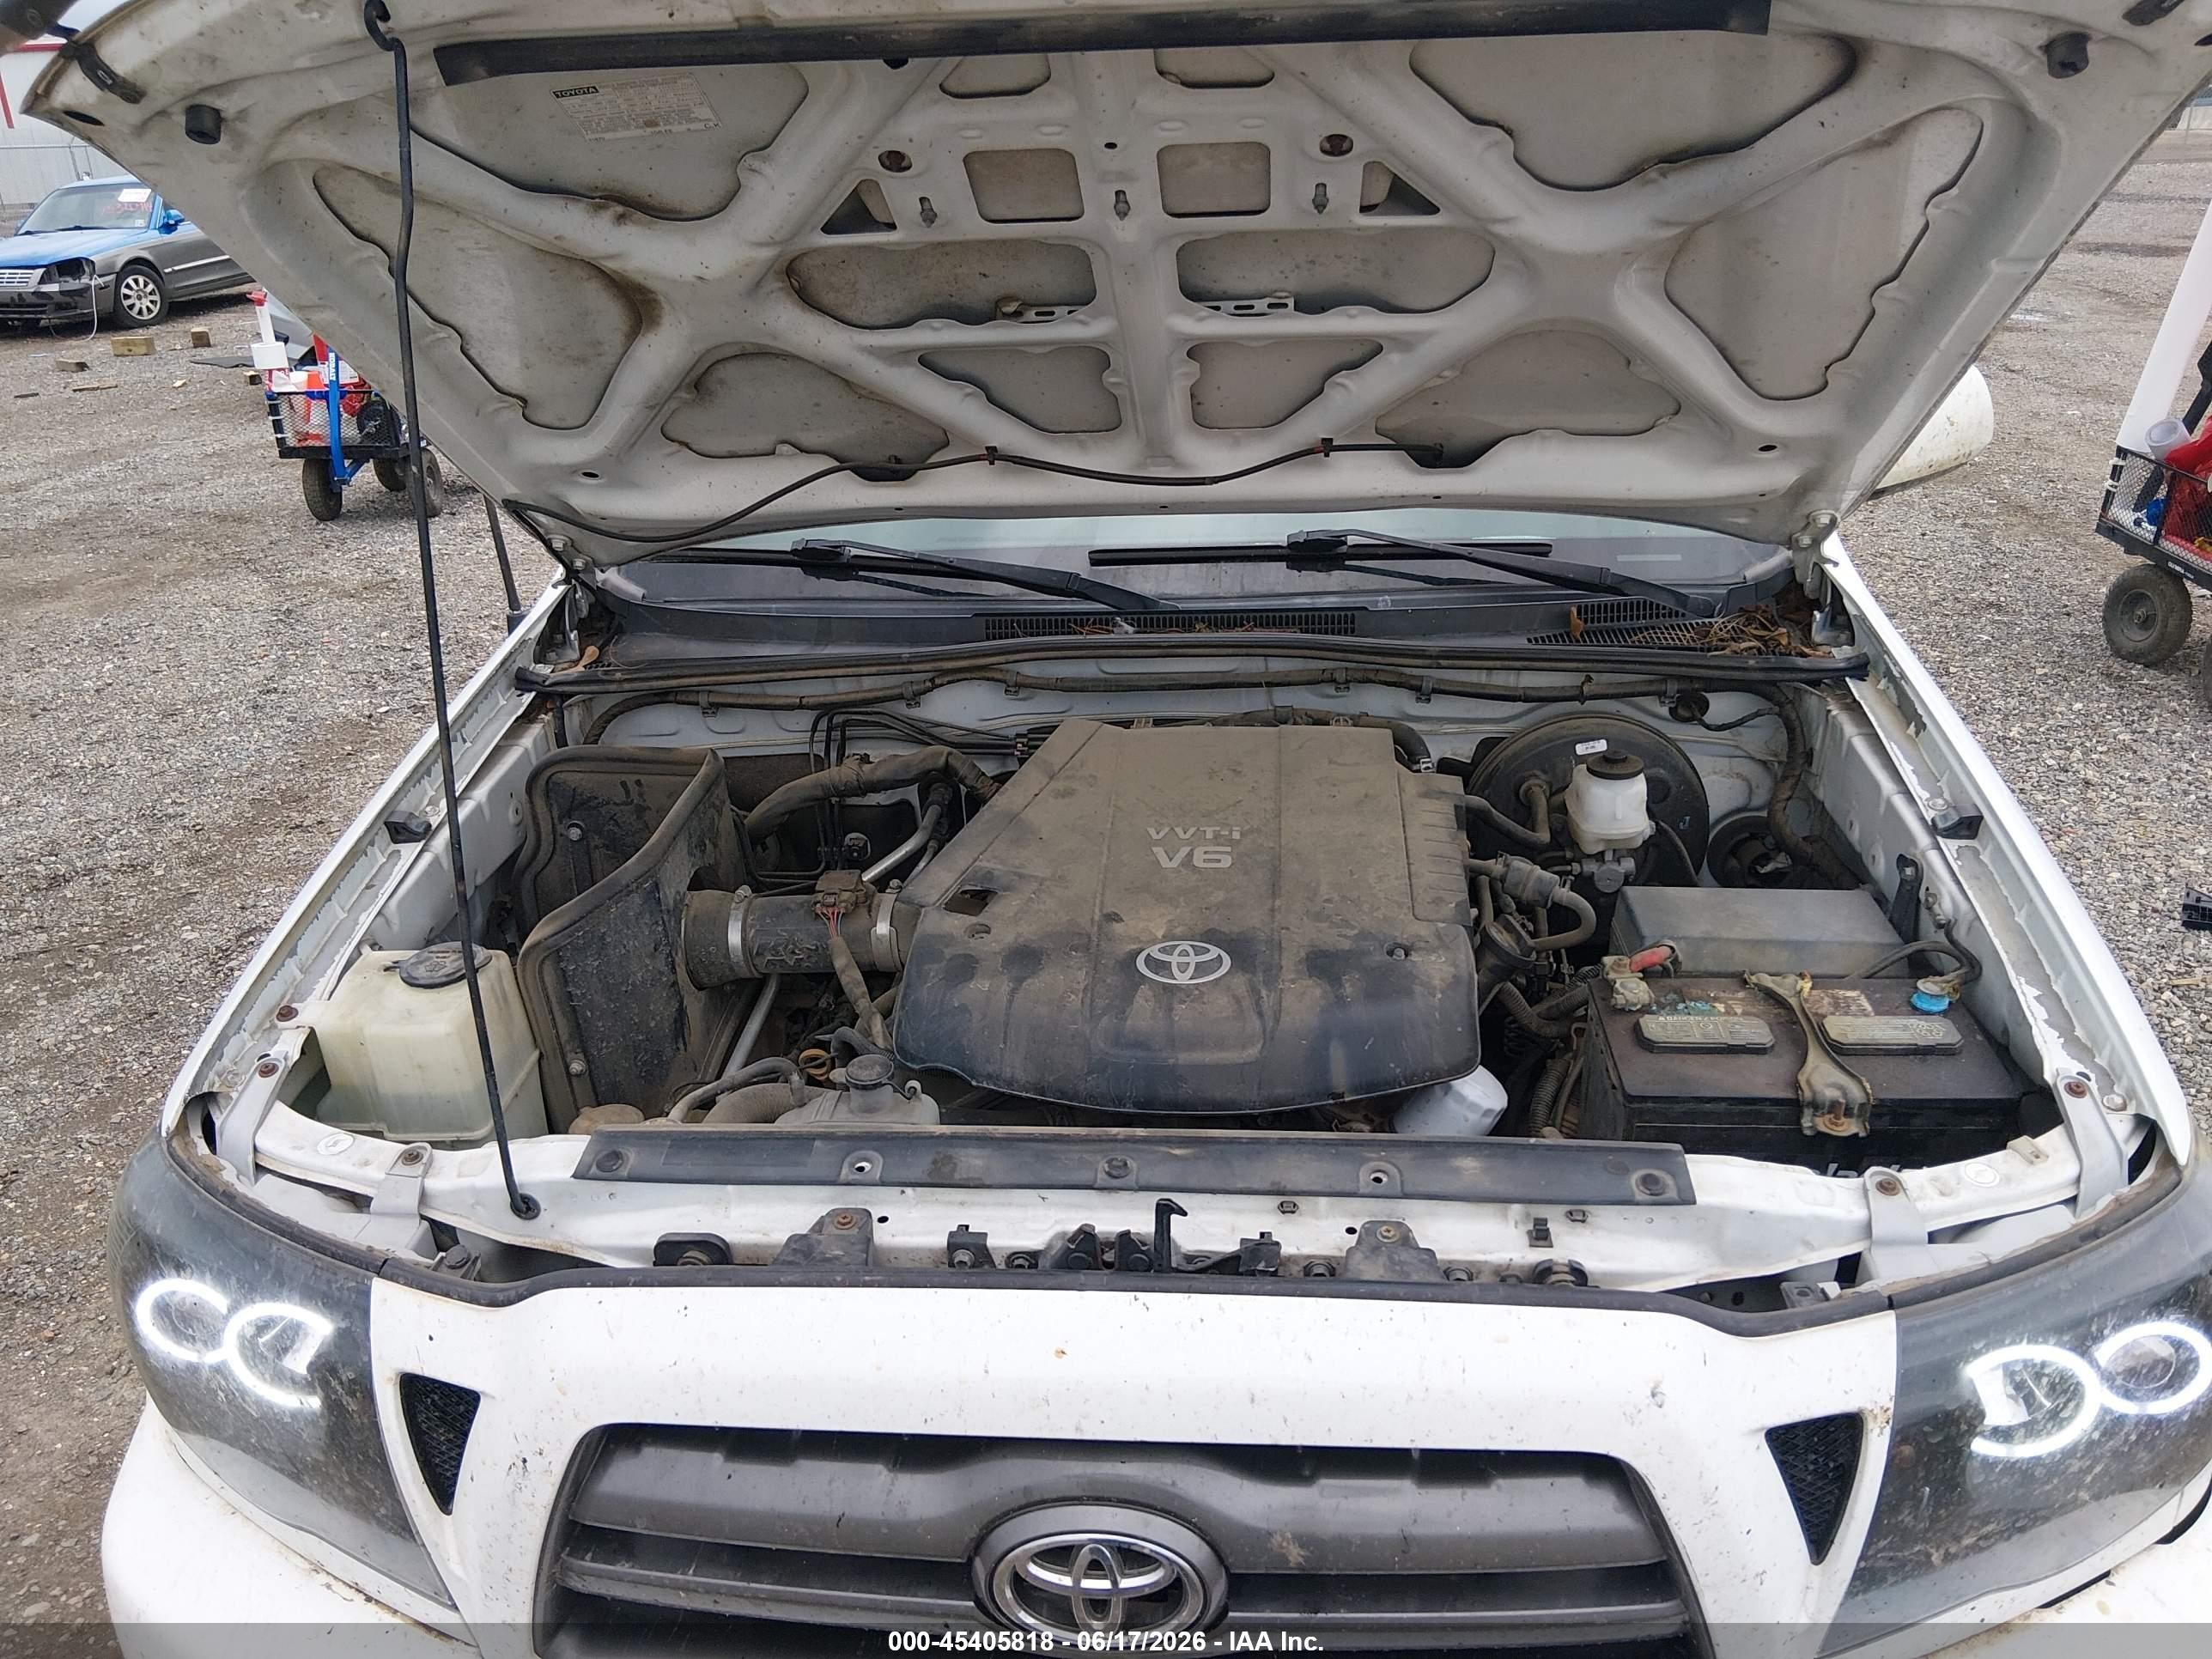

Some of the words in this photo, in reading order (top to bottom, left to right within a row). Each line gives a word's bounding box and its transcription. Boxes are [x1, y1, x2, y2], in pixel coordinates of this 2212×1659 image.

[556, 87, 598, 98] TOYOTA
[1146, 827, 1241, 839] VVT-i
[1152, 846, 1232, 868] V6
